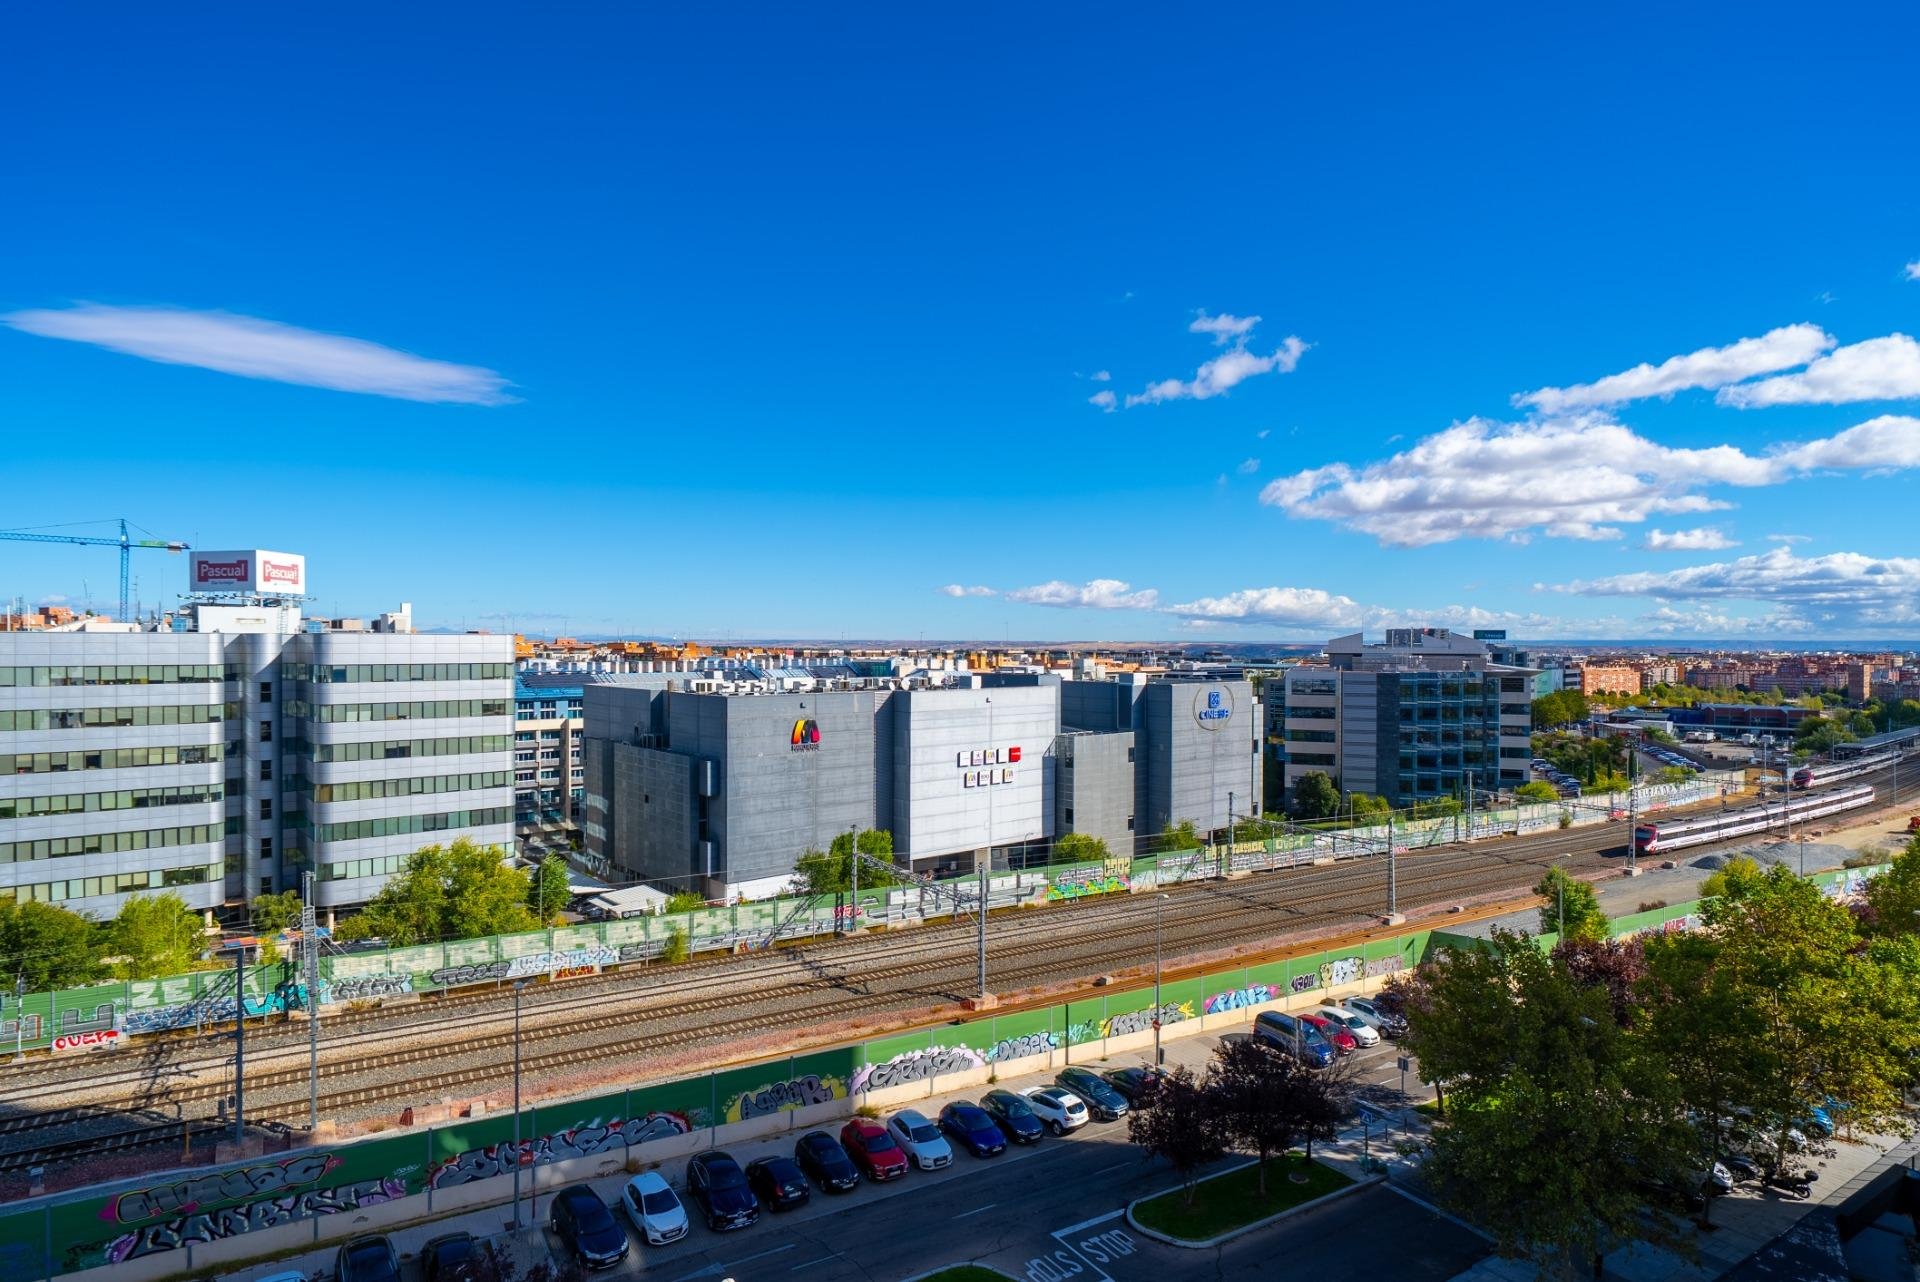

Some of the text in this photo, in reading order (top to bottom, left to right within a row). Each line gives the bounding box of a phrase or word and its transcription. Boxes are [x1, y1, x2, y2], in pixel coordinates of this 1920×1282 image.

[201, 563, 245, 577] Pascual
[265, 564, 298, 580] Pascual
[1080, 1229, 1137, 1263] STOP
